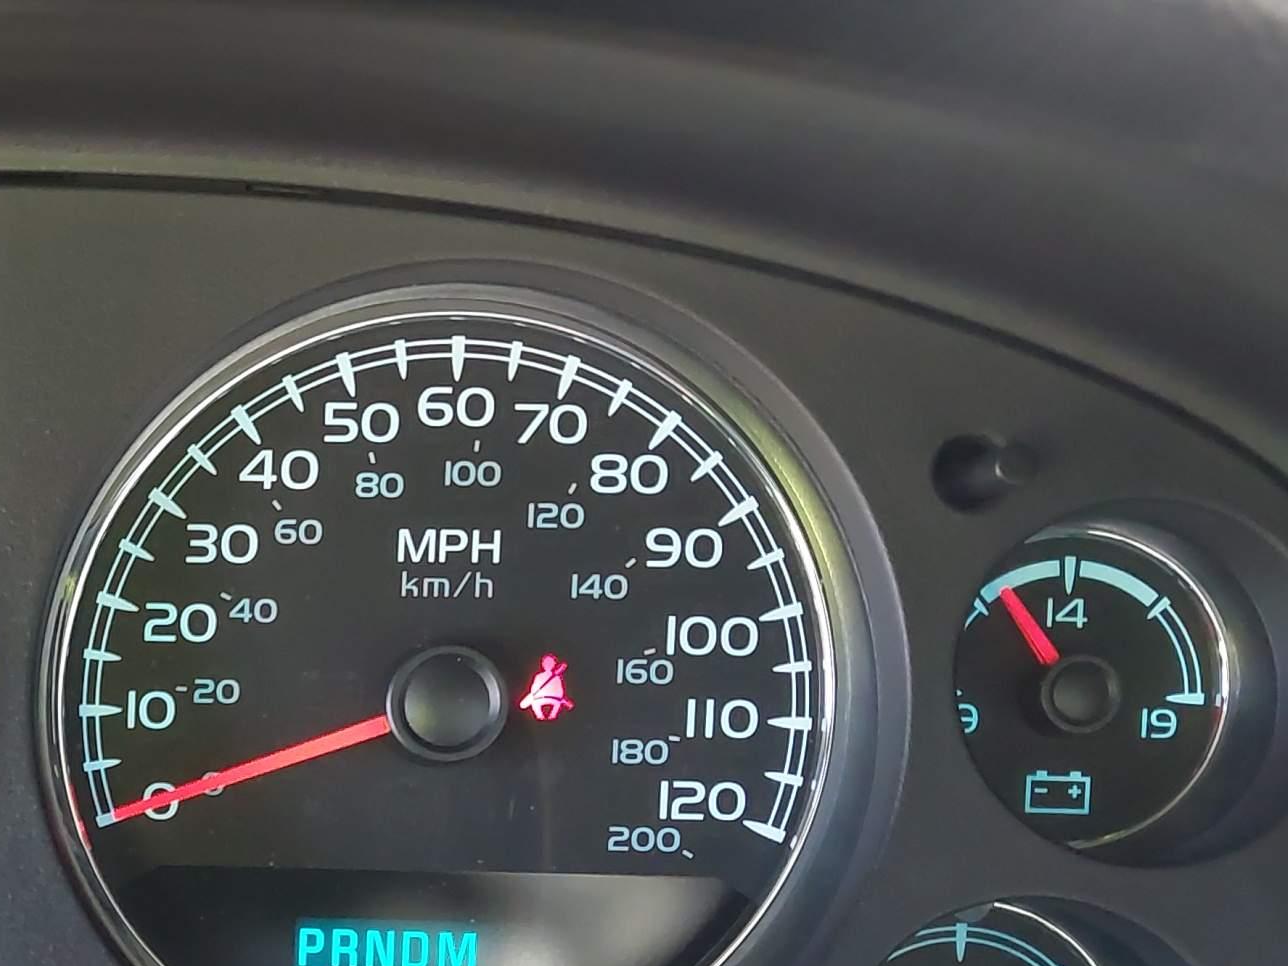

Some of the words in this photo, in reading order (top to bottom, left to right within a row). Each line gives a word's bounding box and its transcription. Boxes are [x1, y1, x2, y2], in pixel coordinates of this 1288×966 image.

[323, 401, 400, 443] 50
[417, 386, 495, 427] 60
[514, 403, 588, 445] 70
[239, 449, 319, 490] 40
[355, 472, 404, 498] 80
[444, 460, 502, 487] 100
[590, 453, 669, 495] 80
[274, 519, 323, 545] 60
[527, 502, 585, 529] 120
[185, 523, 259, 564] 30
[397, 528, 501, 564] MPH
[645, 527, 723, 569] 90
[401, 570, 493, 598] km/h
[571, 573, 628, 600] 140
[143, 602, 217, 643] 20
[227, 597, 278, 623] 40
[1046, 597, 1088, 629] 14
[666, 615, 761, 657] 100
[616, 658, 674, 685] 160
[193, 678, 240, 704] 20
[127, 690, 176, 730] 10
[686, 698, 759, 739] 110
[1141, 708, 1177, 739] 19
[612, 737, 671, 765] 180
[142, 782, 179, 821] 0
[659, 780, 749, 823] 120
[607, 826, 681, 853] 200
